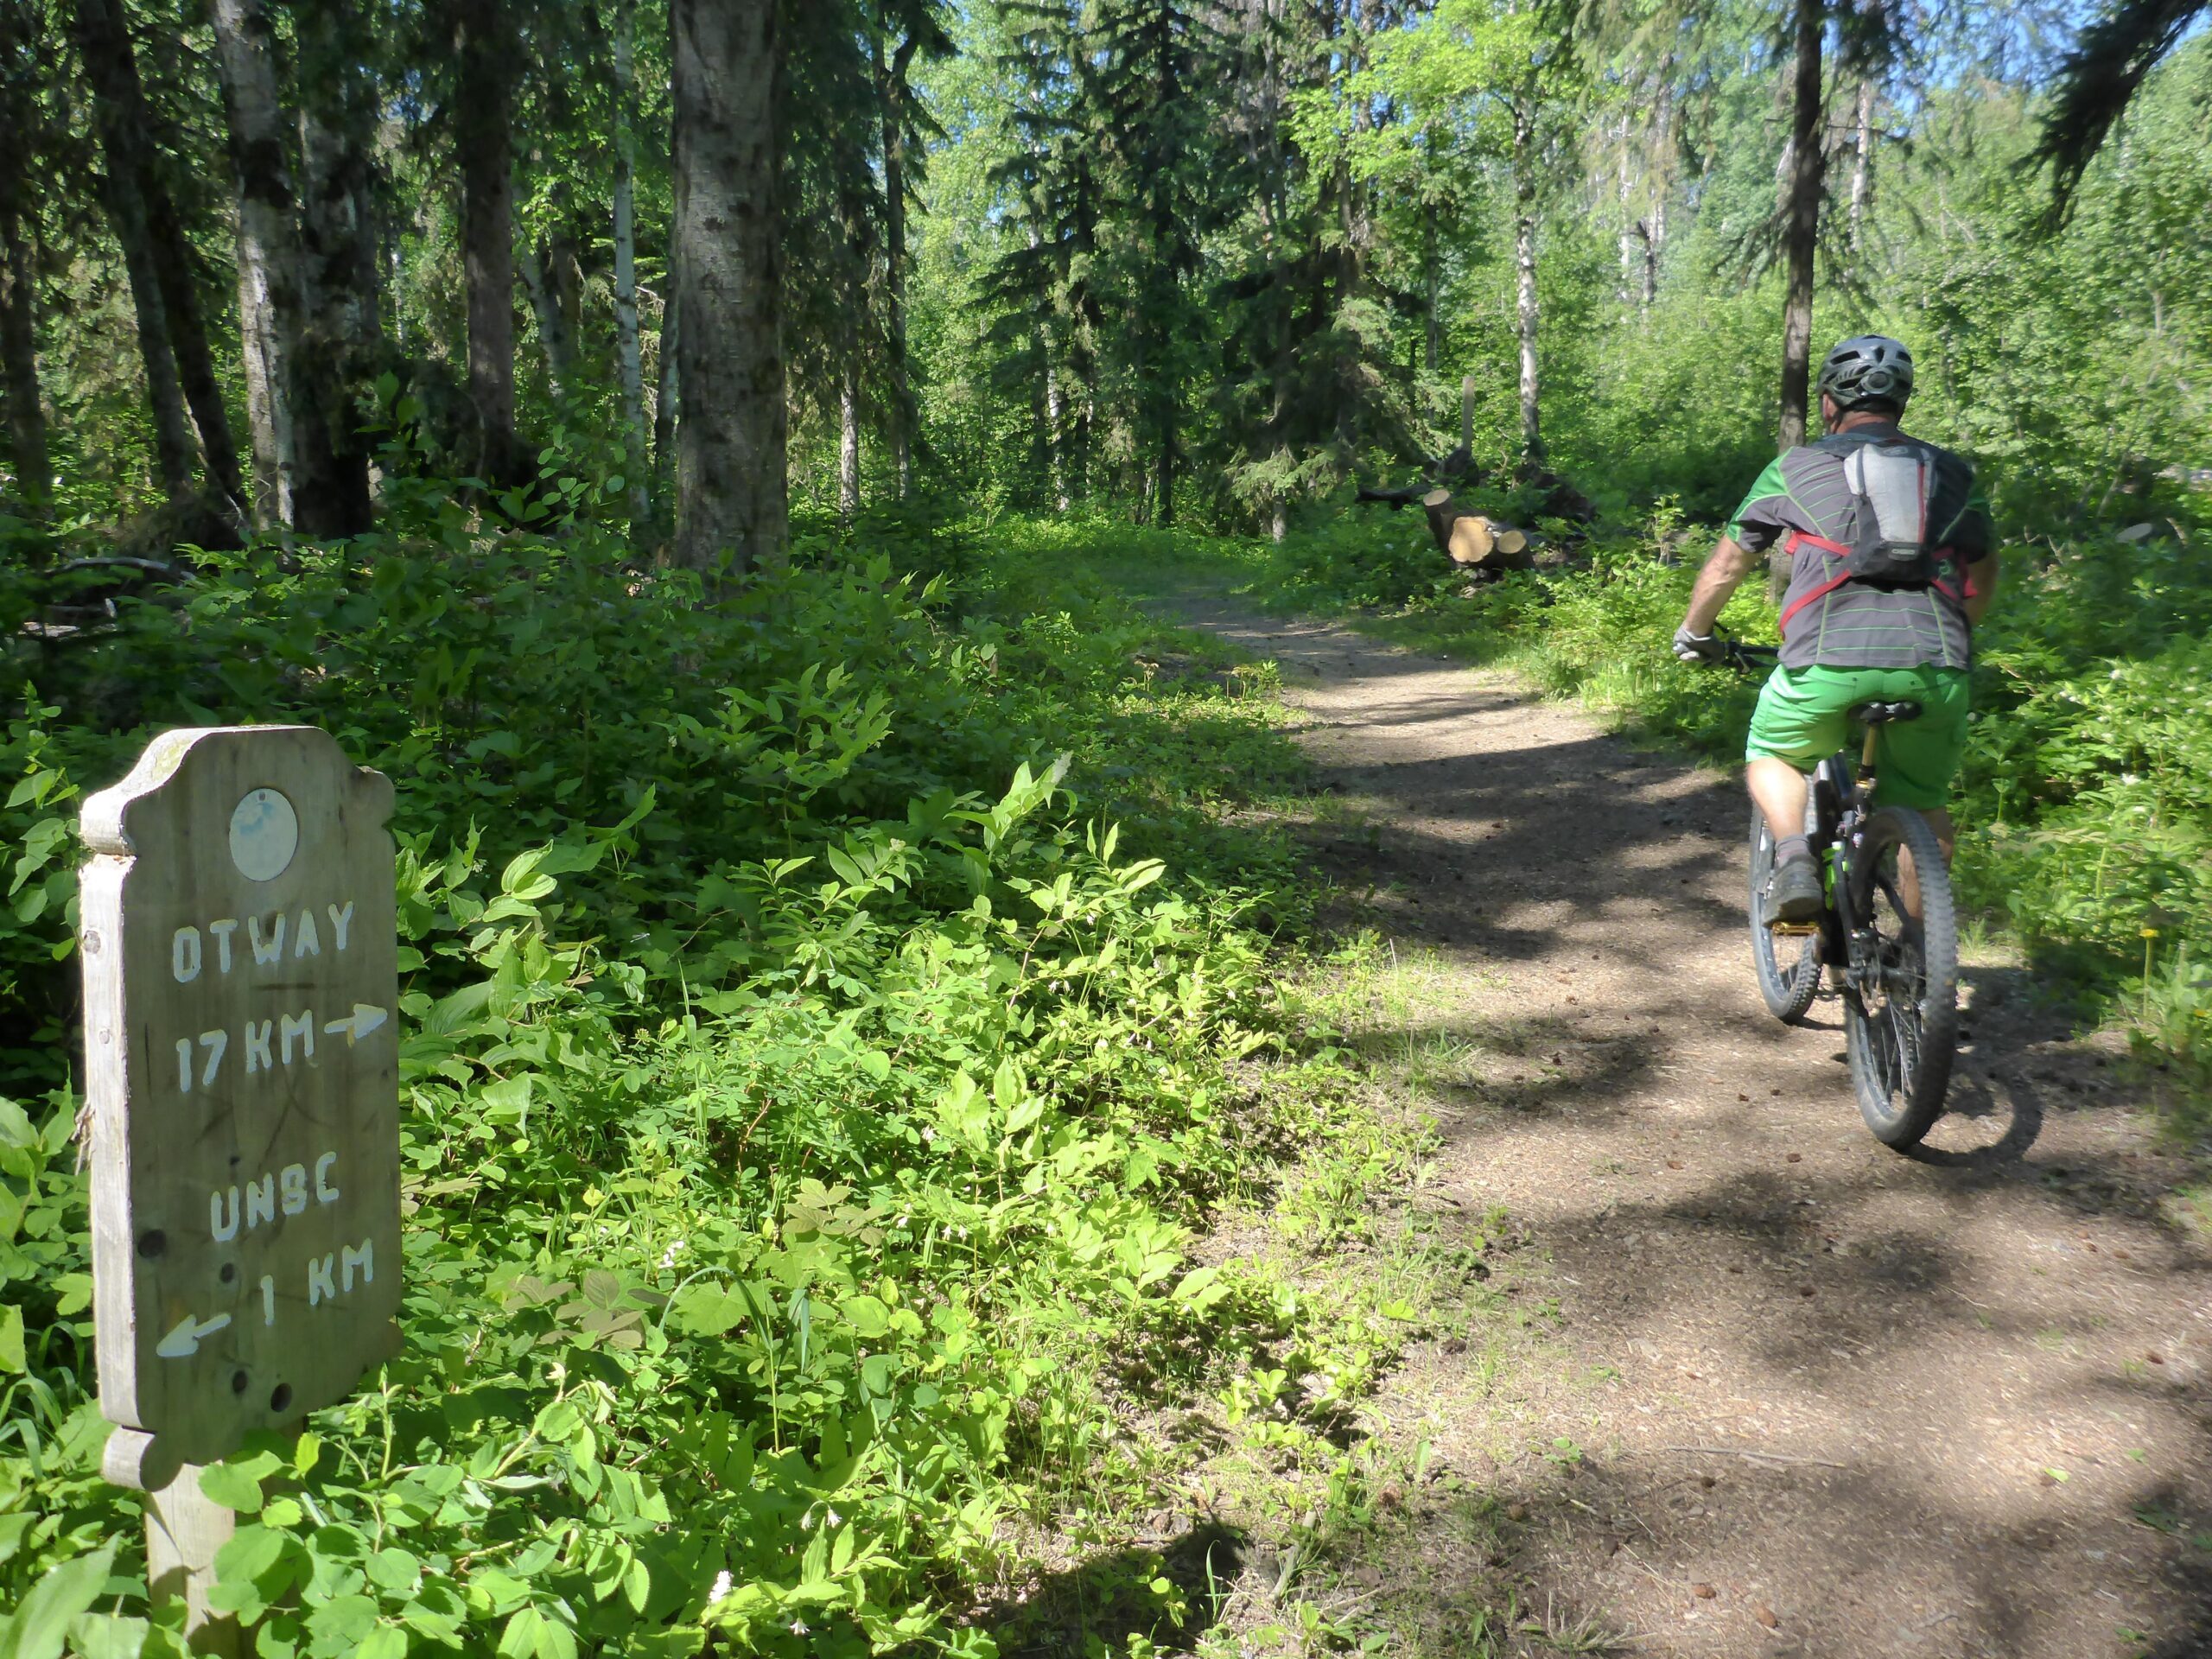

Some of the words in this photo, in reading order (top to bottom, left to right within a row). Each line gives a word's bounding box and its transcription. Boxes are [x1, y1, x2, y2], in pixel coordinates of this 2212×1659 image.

[173, 900, 353, 983] OTWAY
[175, 1028, 228, 1093] 17
[245, 1009, 315, 1074] KM
[210, 1151, 340, 1242] UNBC
[260, 1274, 275, 1326] 1
[308, 1237, 373, 1306] KM
